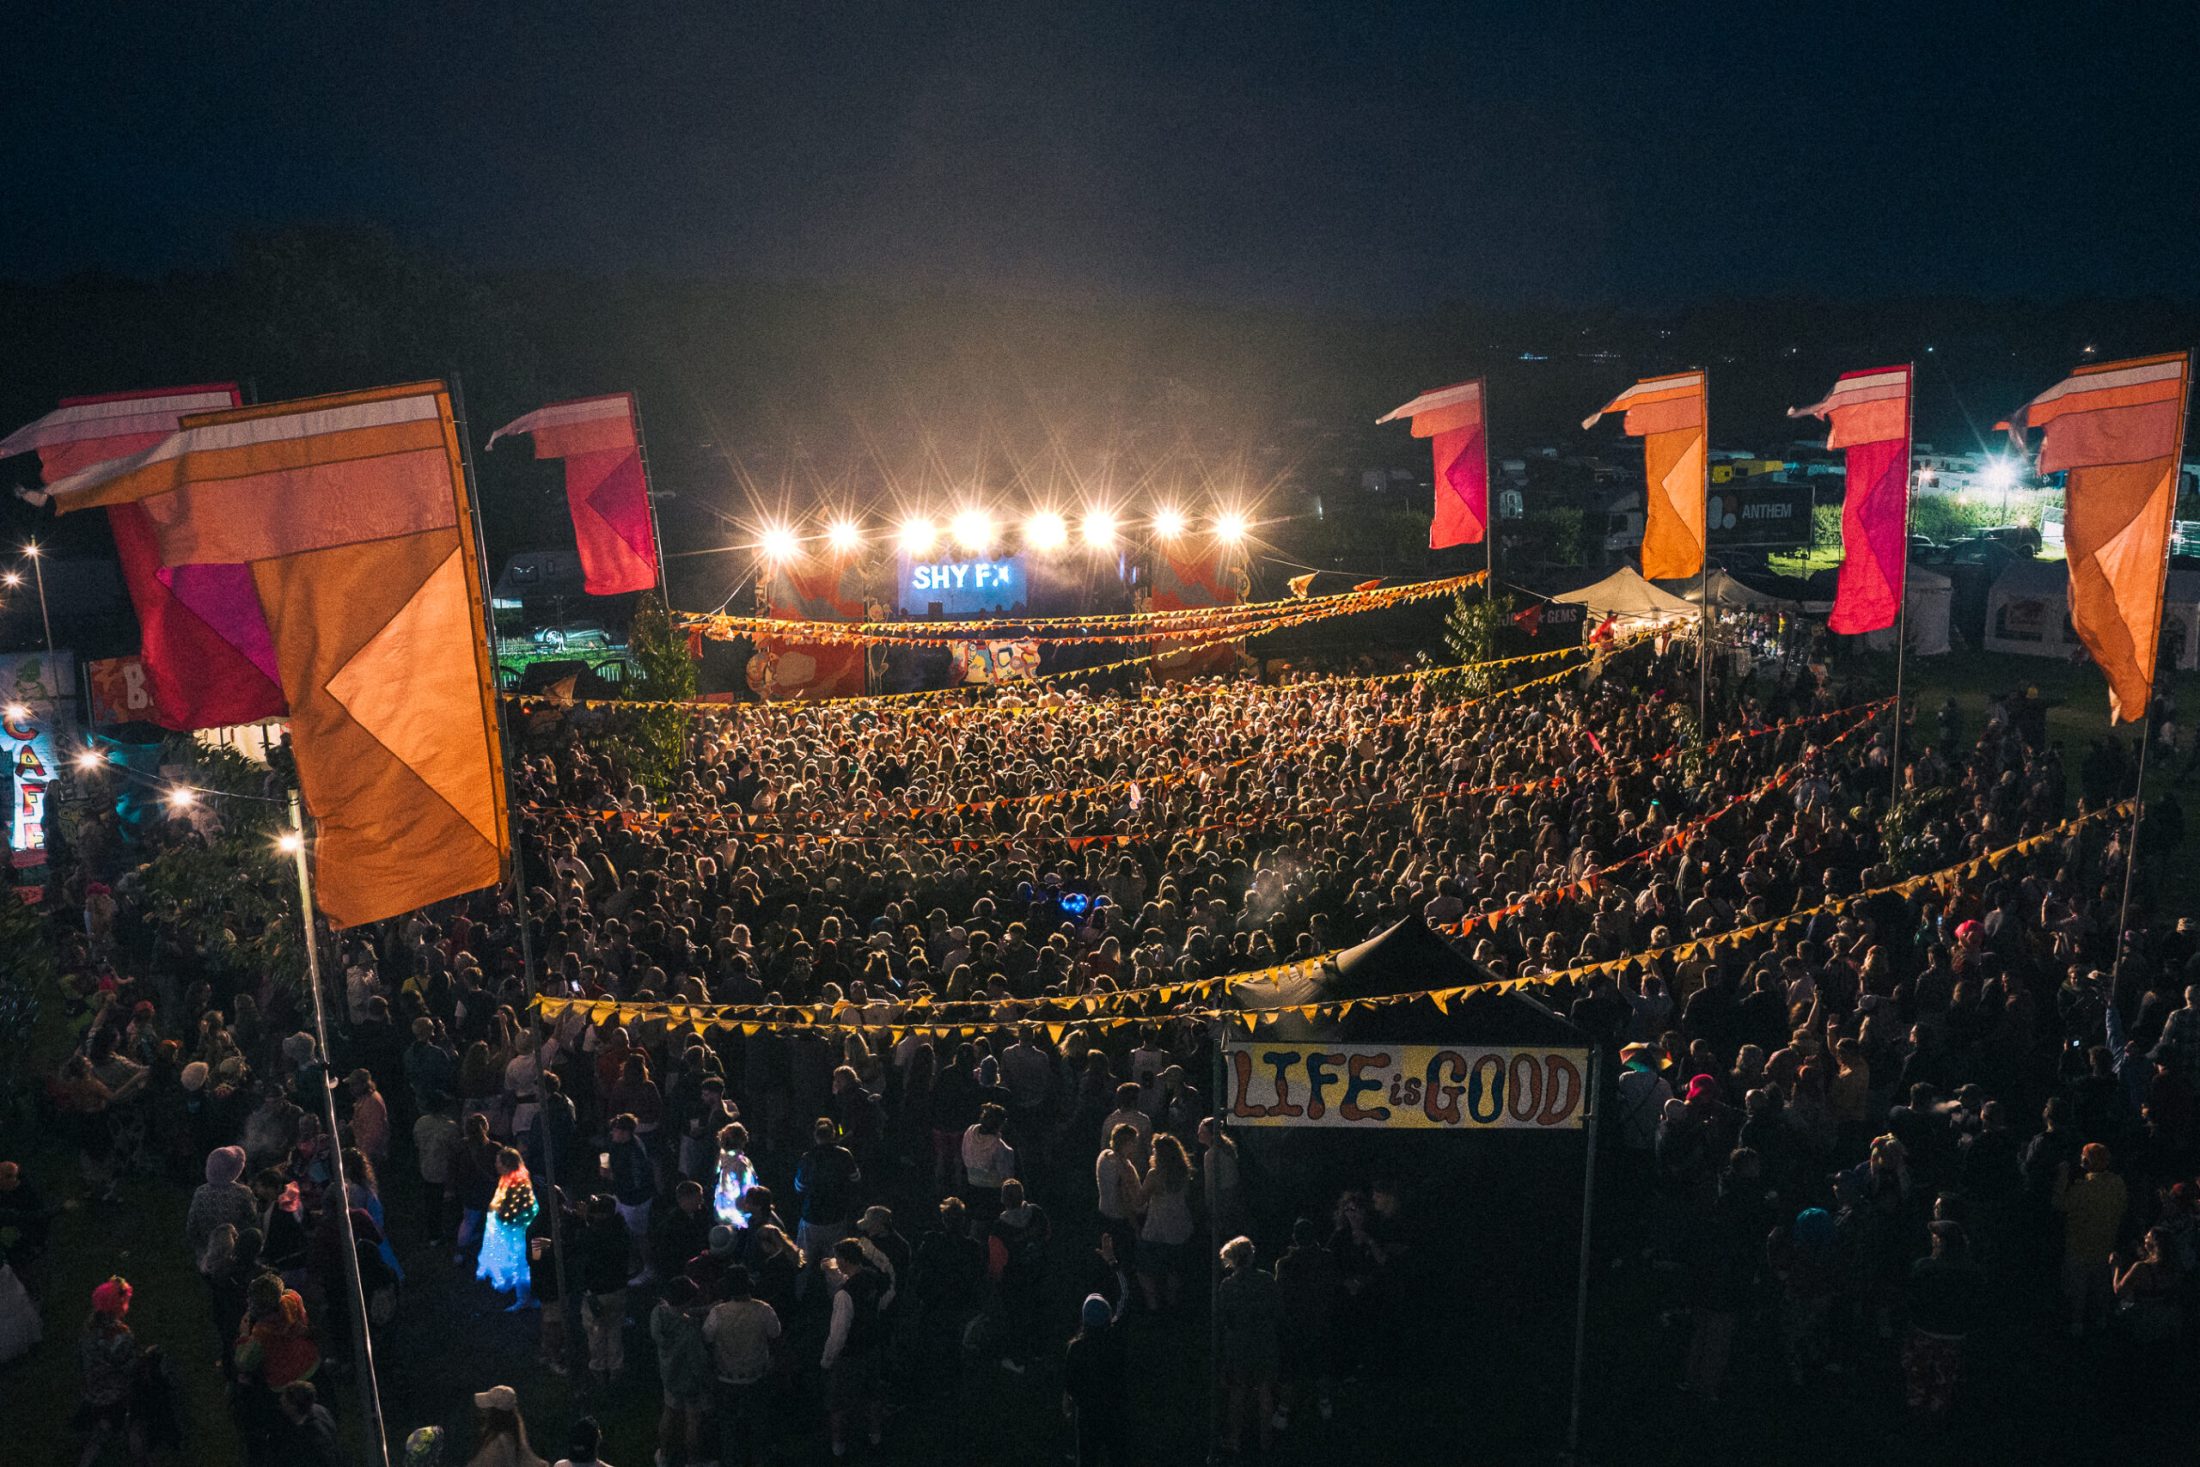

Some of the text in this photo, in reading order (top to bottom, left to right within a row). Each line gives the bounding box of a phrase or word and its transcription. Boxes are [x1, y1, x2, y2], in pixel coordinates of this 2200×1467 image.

[1742, 503, 1792, 519] ANTHEM
[912, 564, 969, 589] SHY
[1547, 608, 1577, 624] GEMS
[1234, 1050, 1581, 1126] LIFE is GOOD
